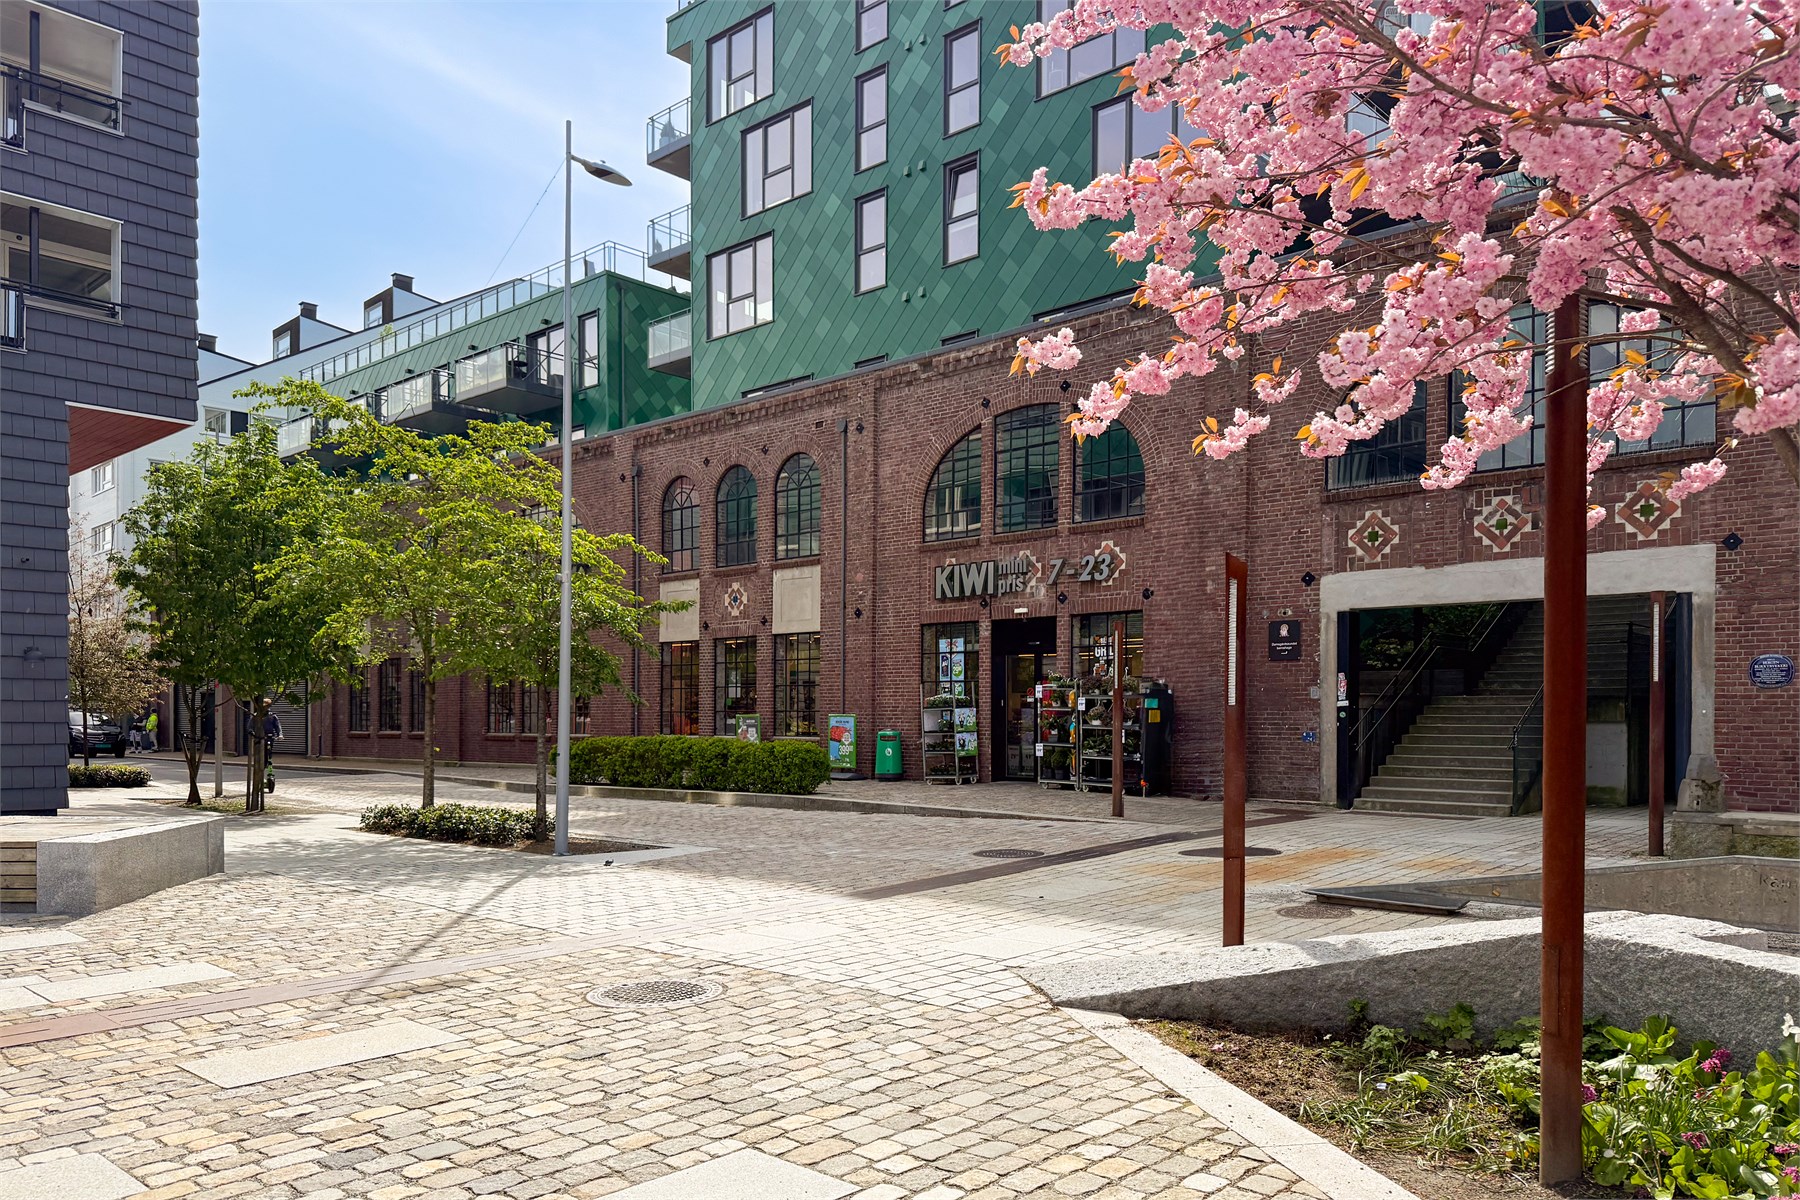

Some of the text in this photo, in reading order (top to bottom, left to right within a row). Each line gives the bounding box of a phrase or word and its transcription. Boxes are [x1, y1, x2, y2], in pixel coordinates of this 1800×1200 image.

[999, 557, 1028, 575] mini
[1047, 558, 1065, 585] 7
[1078, 553, 1112, 582] 23
[935, 560, 997, 599] KIWI
[998, 575, 1025, 596] pris
